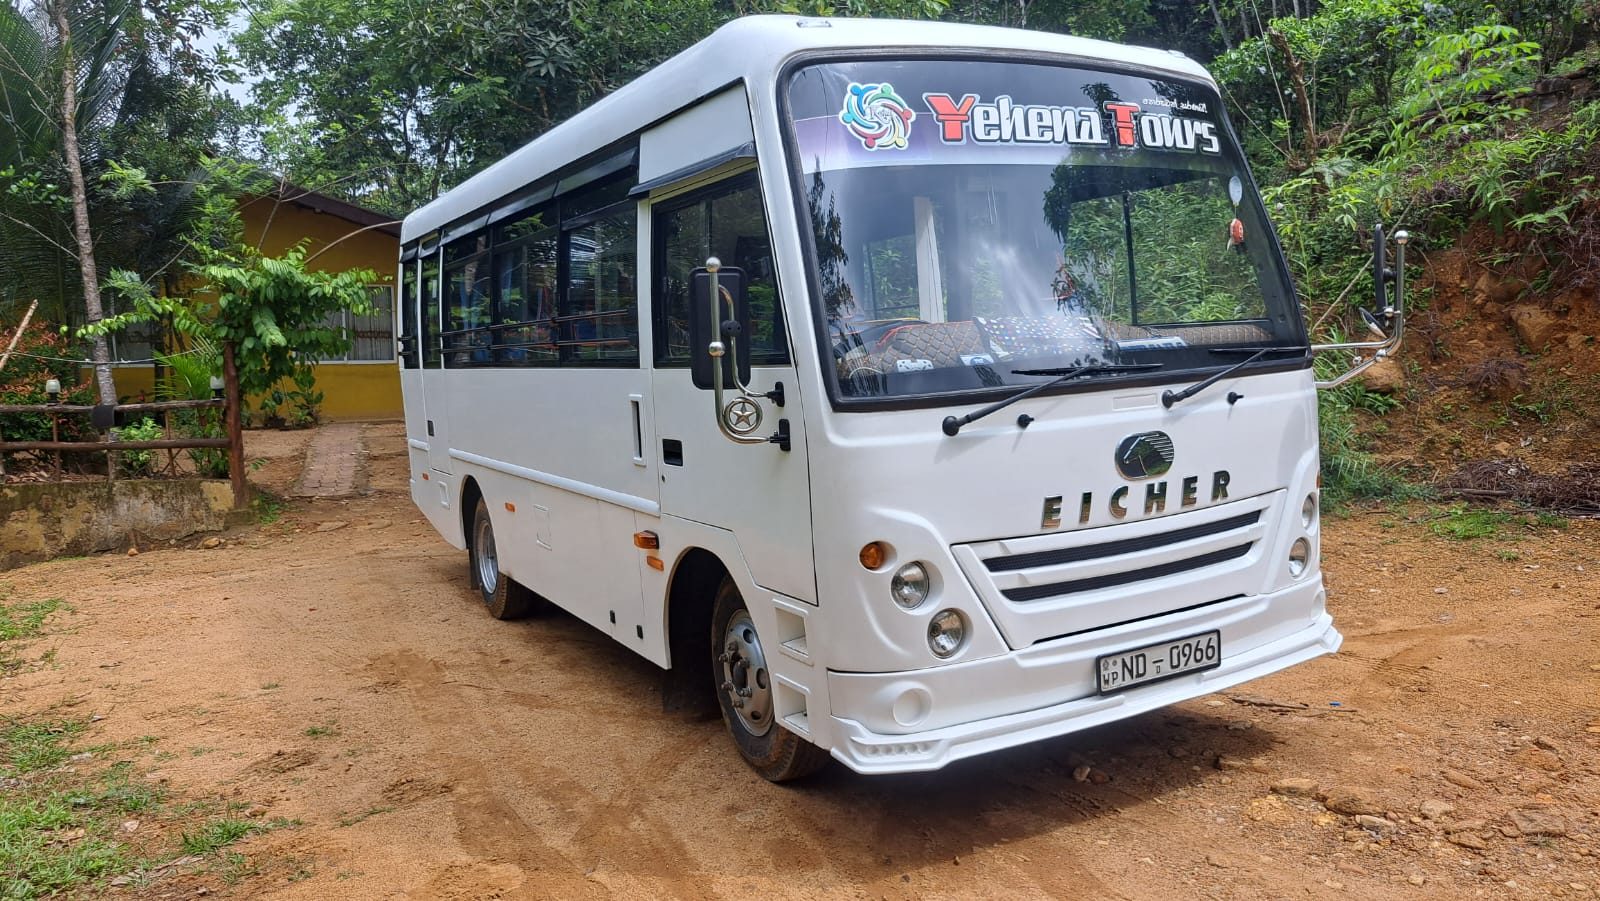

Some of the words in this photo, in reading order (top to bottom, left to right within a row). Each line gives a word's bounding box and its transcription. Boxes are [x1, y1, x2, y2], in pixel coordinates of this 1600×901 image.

[924, 93, 1108, 145] Yehena
[1105, 102, 1219, 153] Tours
[1041, 470, 1231, 529] EICHER
[1169, 637, 1216, 669] 0966
[1102, 671, 1119, 686] WP
